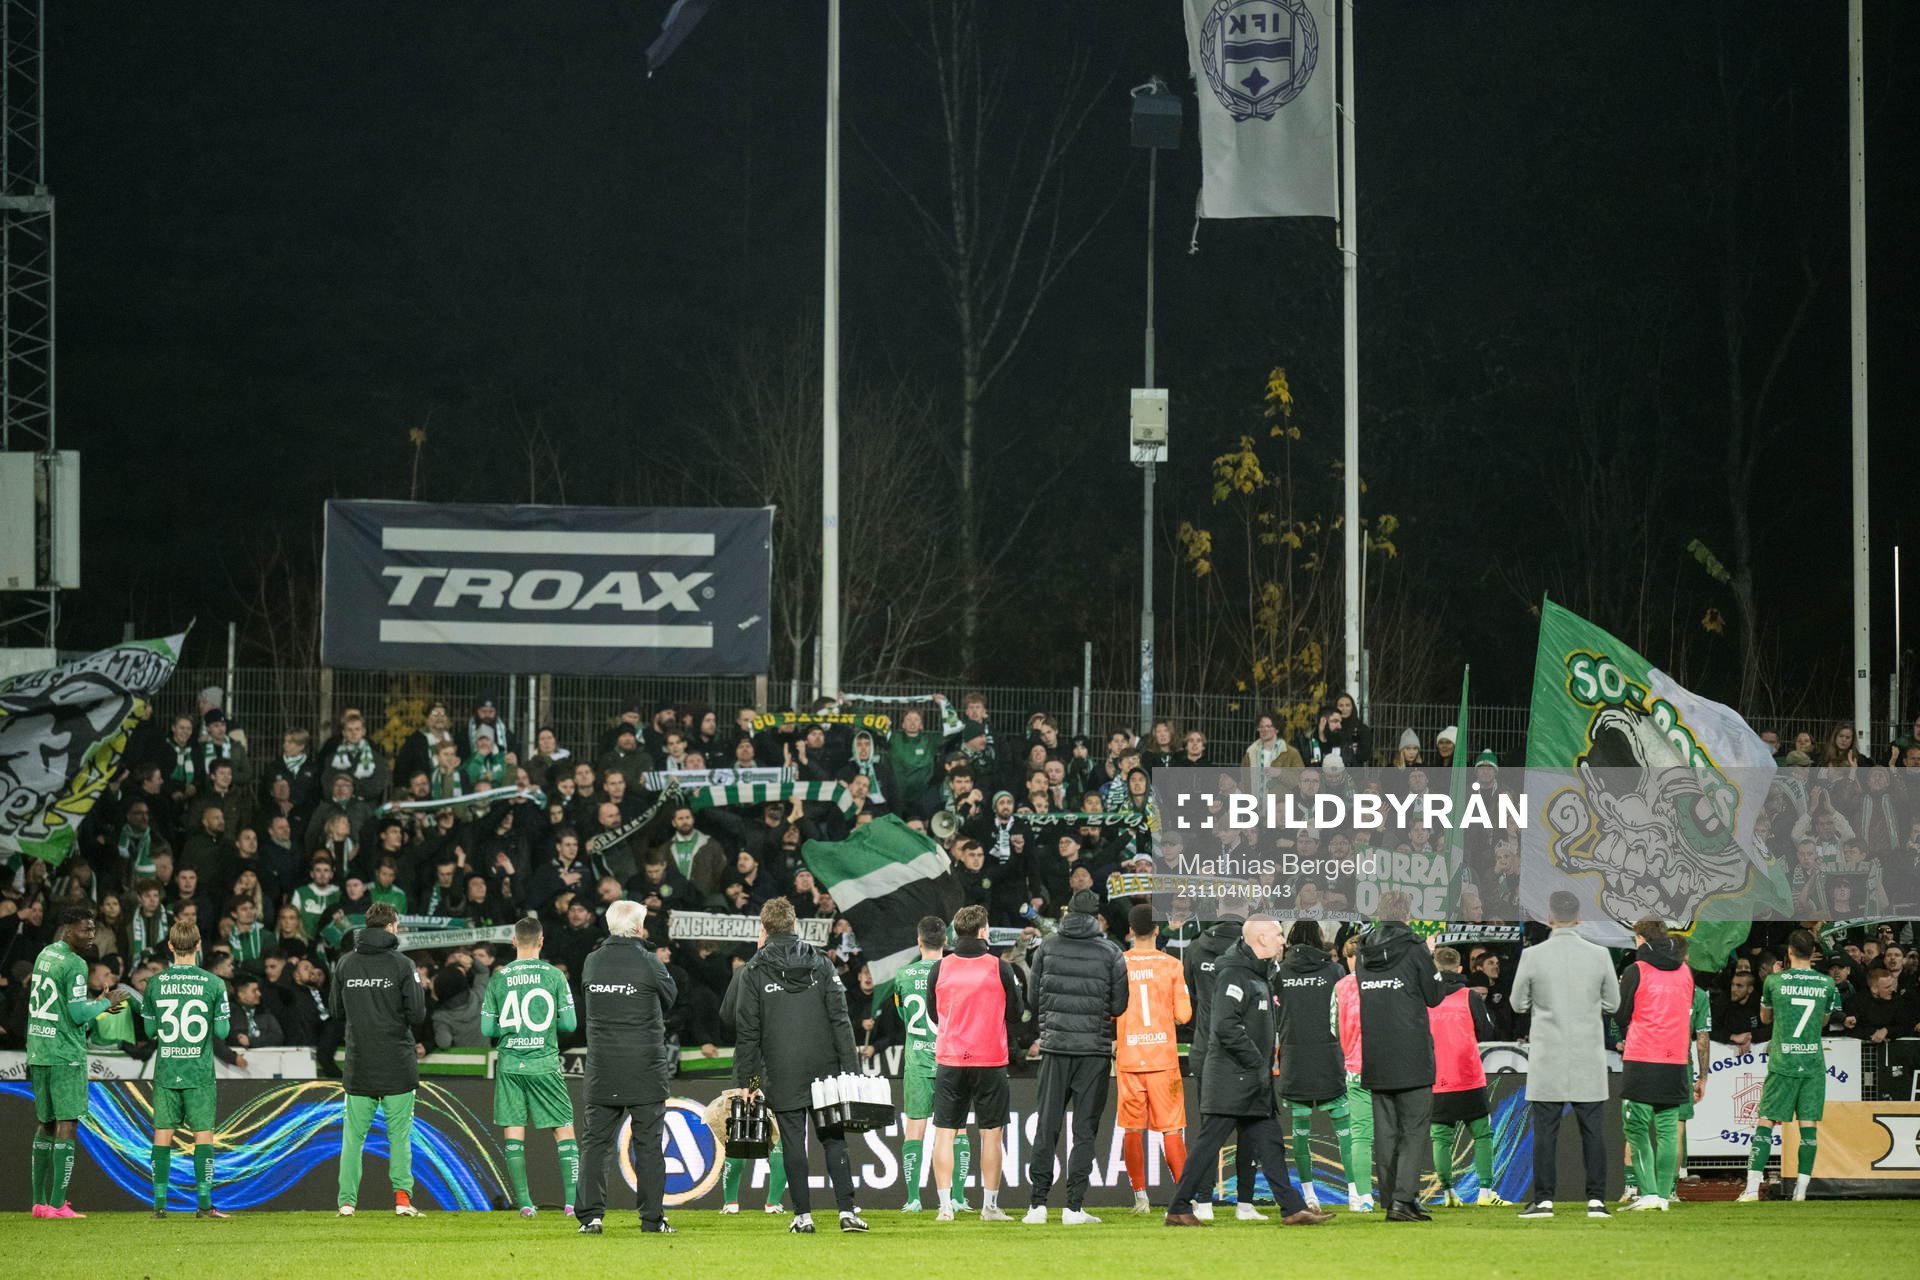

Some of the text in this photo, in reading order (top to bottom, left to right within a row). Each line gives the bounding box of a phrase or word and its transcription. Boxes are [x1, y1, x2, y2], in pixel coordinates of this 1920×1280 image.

[381, 566, 713, 612] TROAX
[346, 979, 383, 988] CRAFT
[506, 974, 541, 987] BOUDAH
[1360, 979, 1394, 990] CRAFT
[160, 984, 204, 996] KARLSSON
[588, 983, 626, 994] CRAFT
[28, 973, 59, 1021] 32
[499, 987, 555, 1034] 40
[1139, 983, 1152, 1027] 1
[155, 999, 209, 1043] 36
[1790, 997, 1816, 1038] 7
[513, 1037, 545, 1046] PROJOB
[171, 1046, 202, 1055] PROJOB
